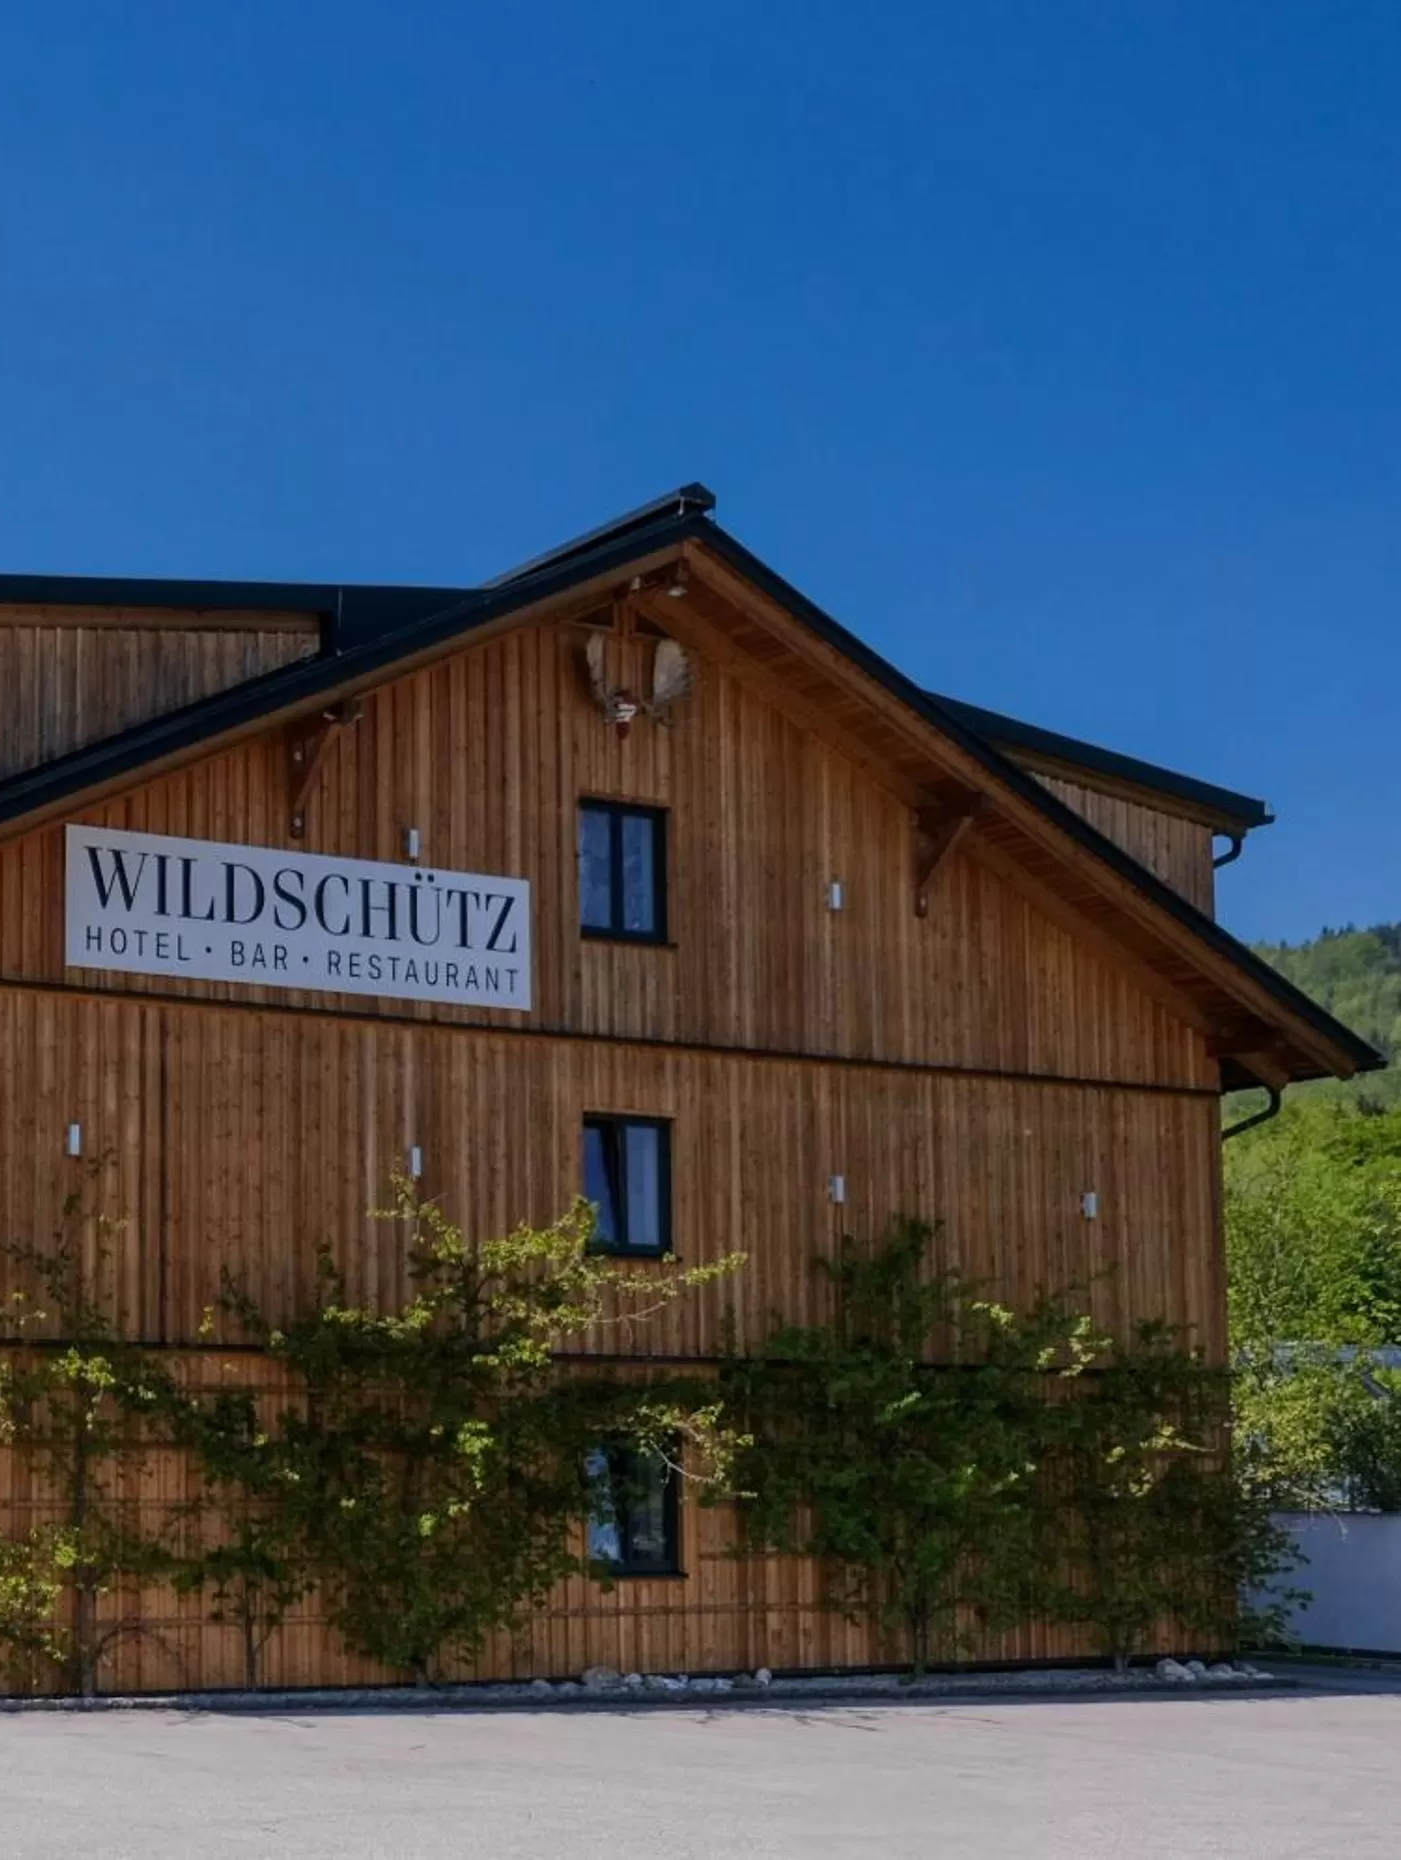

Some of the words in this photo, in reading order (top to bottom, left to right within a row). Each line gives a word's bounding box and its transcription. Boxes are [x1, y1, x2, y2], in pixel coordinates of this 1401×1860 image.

[84, 846, 517, 953] WILDSCHÜTZ
[86, 925, 191, 961] HOTEL
[231, 940, 288, 971] BAR
[328, 950, 519, 993] RESTAURANT
